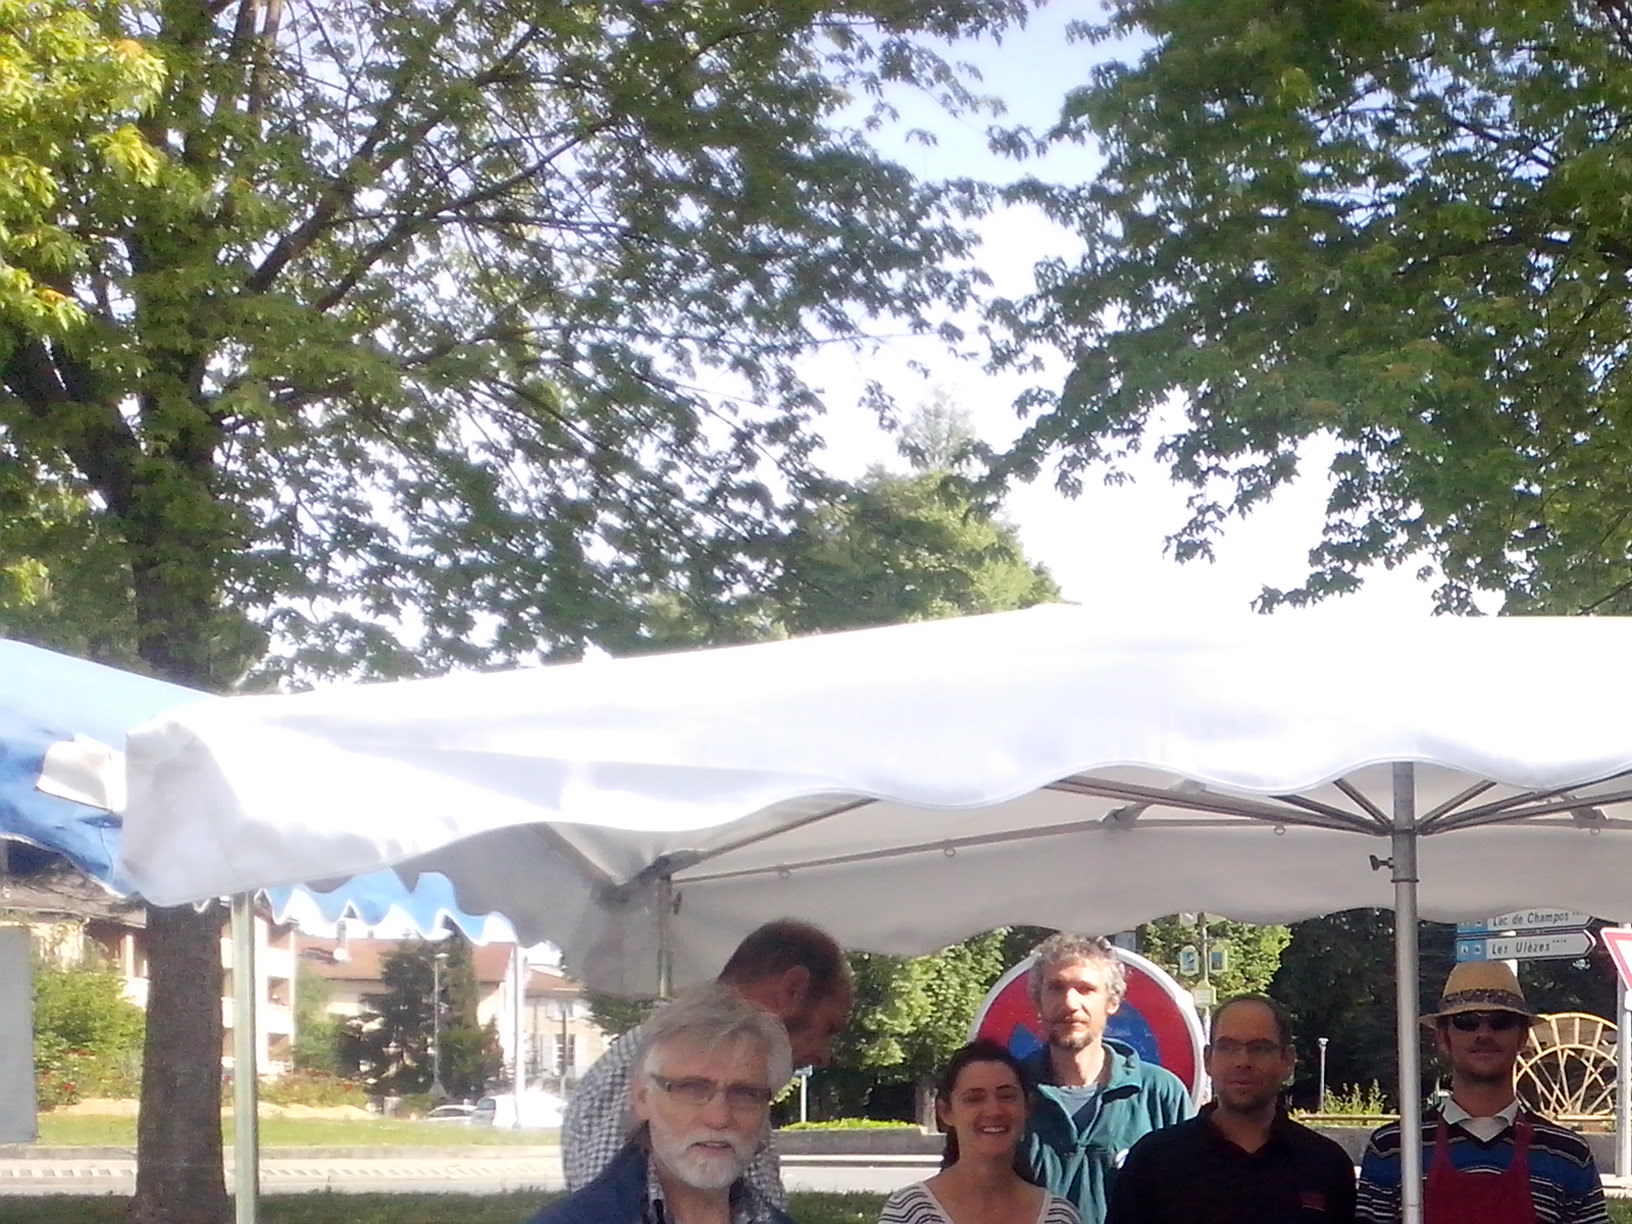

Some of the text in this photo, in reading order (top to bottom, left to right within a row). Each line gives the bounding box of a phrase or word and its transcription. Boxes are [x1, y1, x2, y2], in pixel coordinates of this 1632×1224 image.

[1493, 911, 1569, 927] Lac de Champos
[1492, 943, 1508, 955] Les
